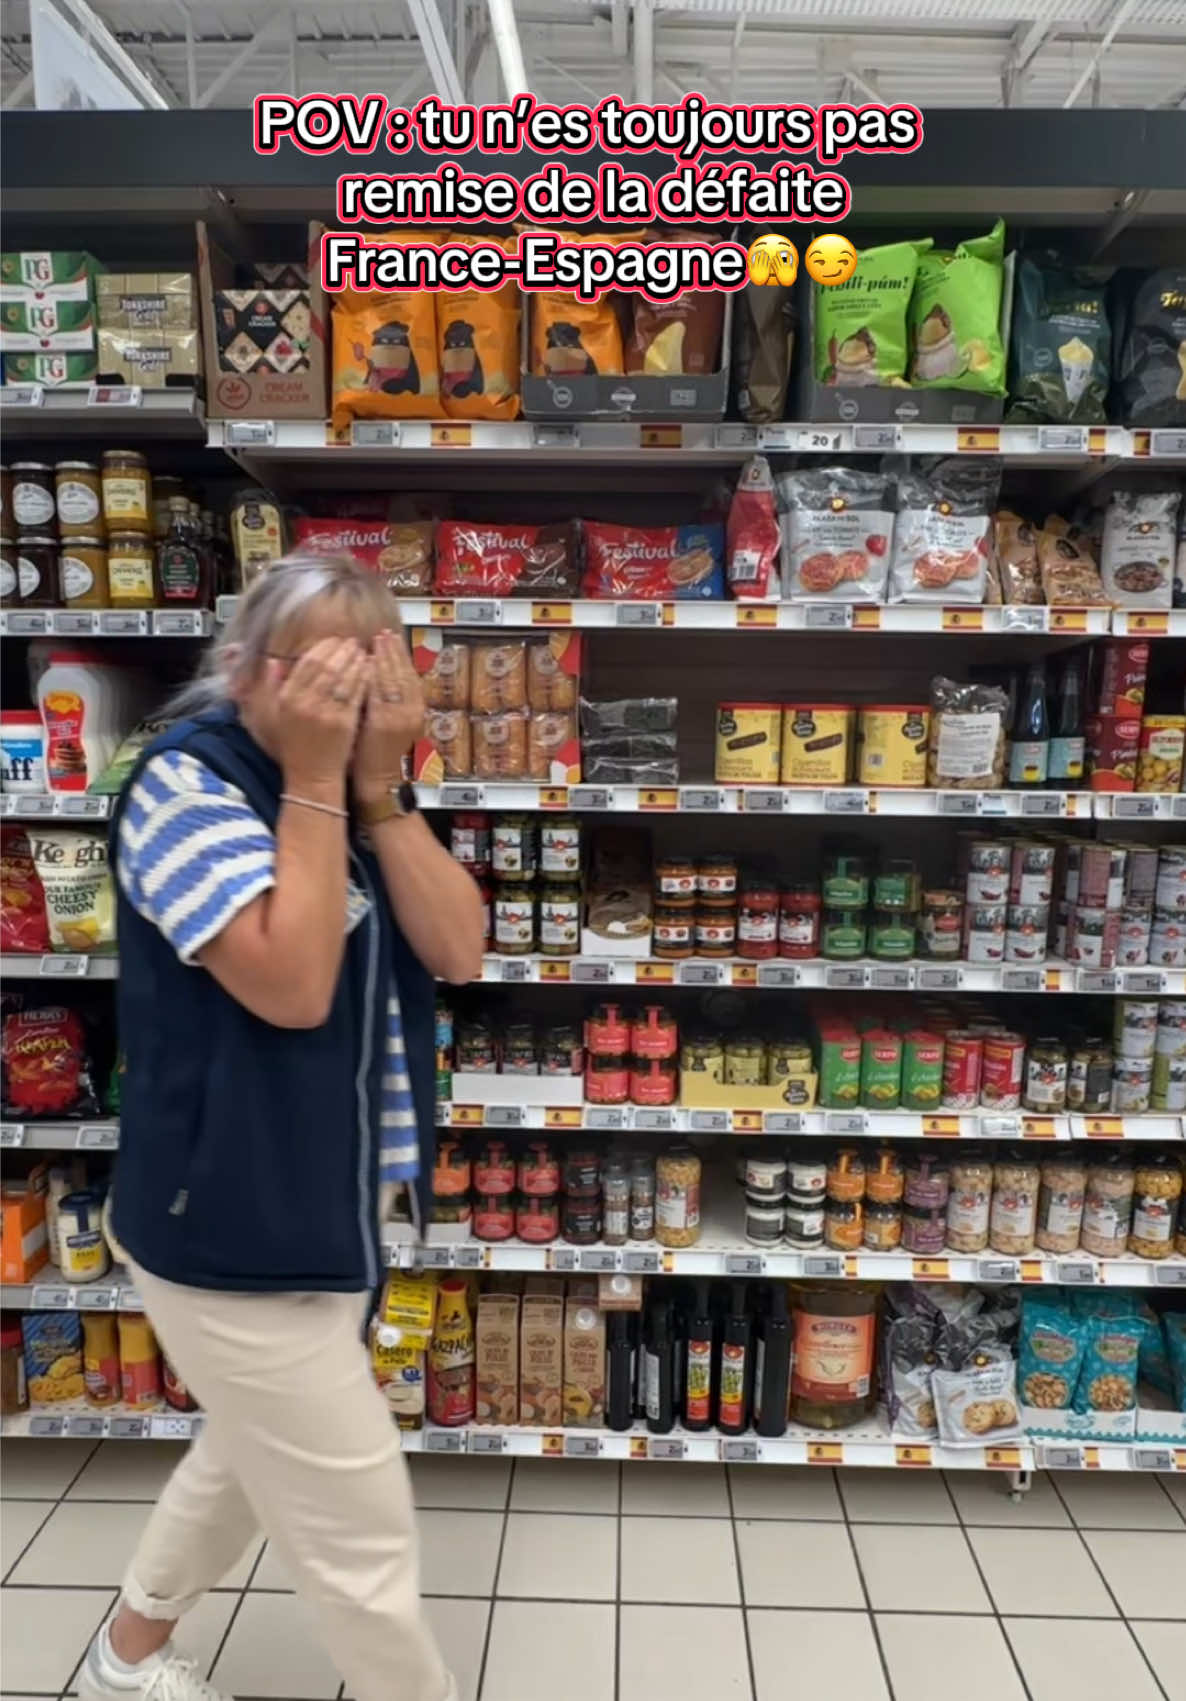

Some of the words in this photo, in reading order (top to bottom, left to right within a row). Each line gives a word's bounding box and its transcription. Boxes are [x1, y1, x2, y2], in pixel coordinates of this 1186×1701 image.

[25, 257, 50, 282] PG
[30, 307, 55, 331] PG
[40, 358, 65, 378] PG
[812, 435, 829, 447] 20
[599, 537, 682, 560] Festival
[54, 901, 95, 914] ONION
